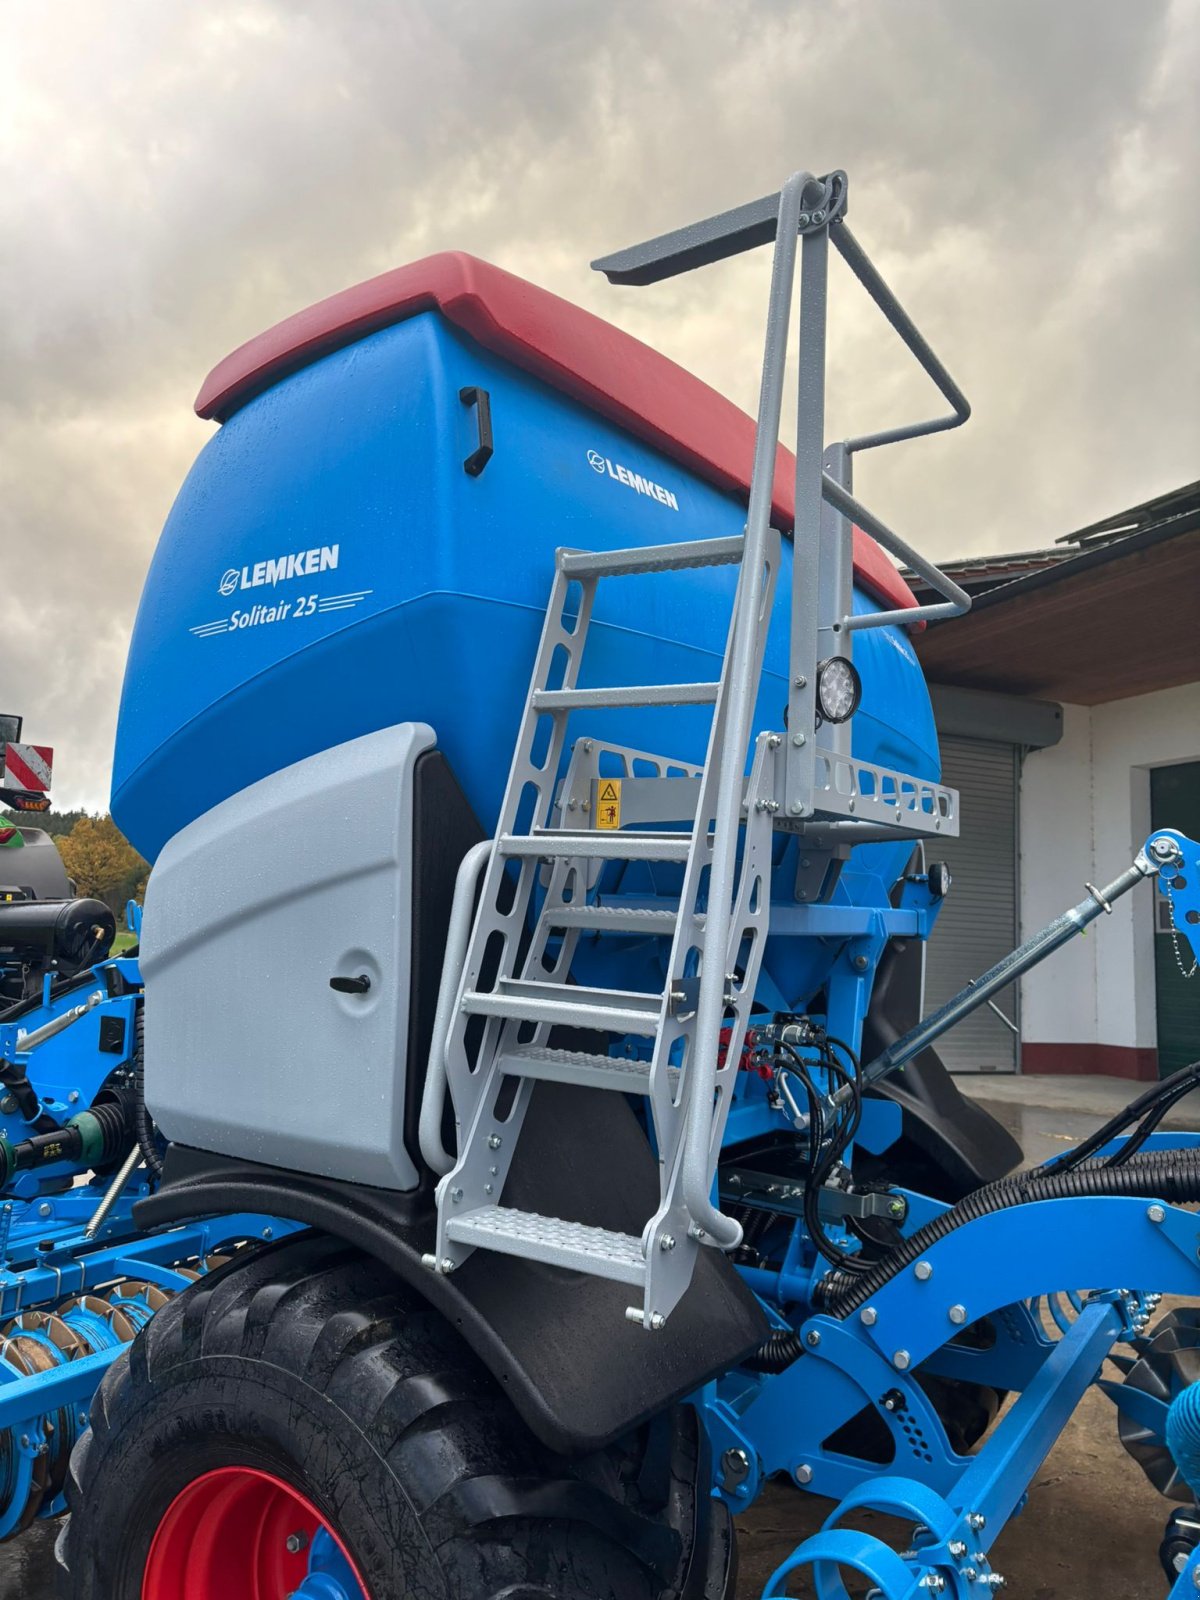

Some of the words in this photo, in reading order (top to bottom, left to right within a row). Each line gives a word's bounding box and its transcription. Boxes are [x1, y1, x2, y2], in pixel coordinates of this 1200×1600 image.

[605, 458, 679, 511] LEMKEN
[240, 544, 339, 588] LEMKEN
[228, 600, 291, 631] Solitair
[292, 594, 319, 618] 25
